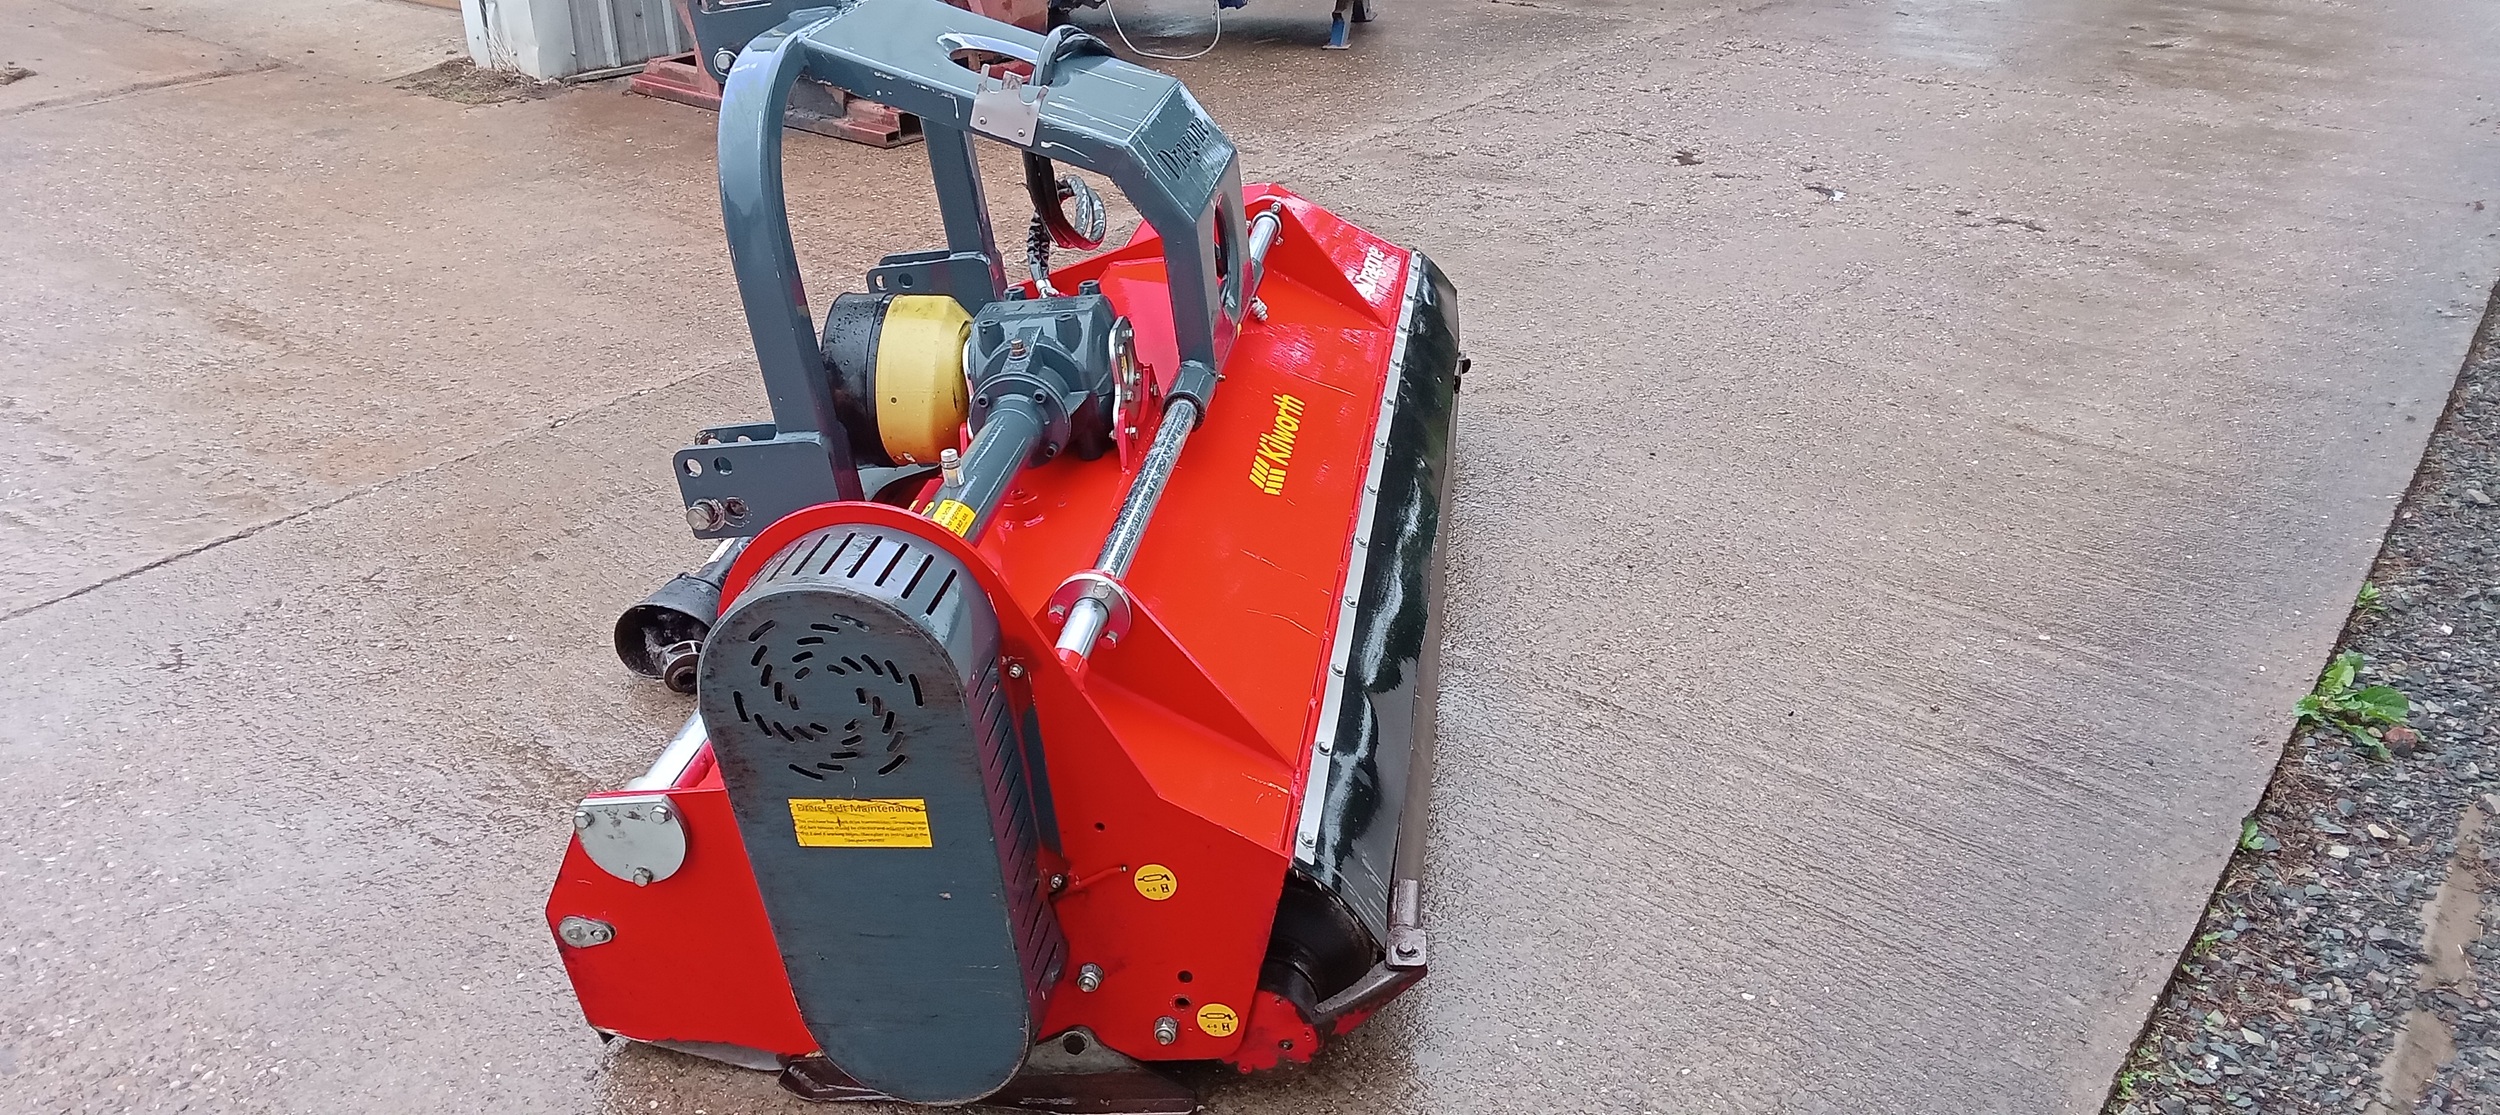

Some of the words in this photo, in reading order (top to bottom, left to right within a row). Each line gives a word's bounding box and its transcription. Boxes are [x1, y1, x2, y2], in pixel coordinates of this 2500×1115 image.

[1156, 116, 1209, 180] Dragone
[1355, 246, 1387, 288] Dragone
[1256, 394, 1306, 466] Kilworth
